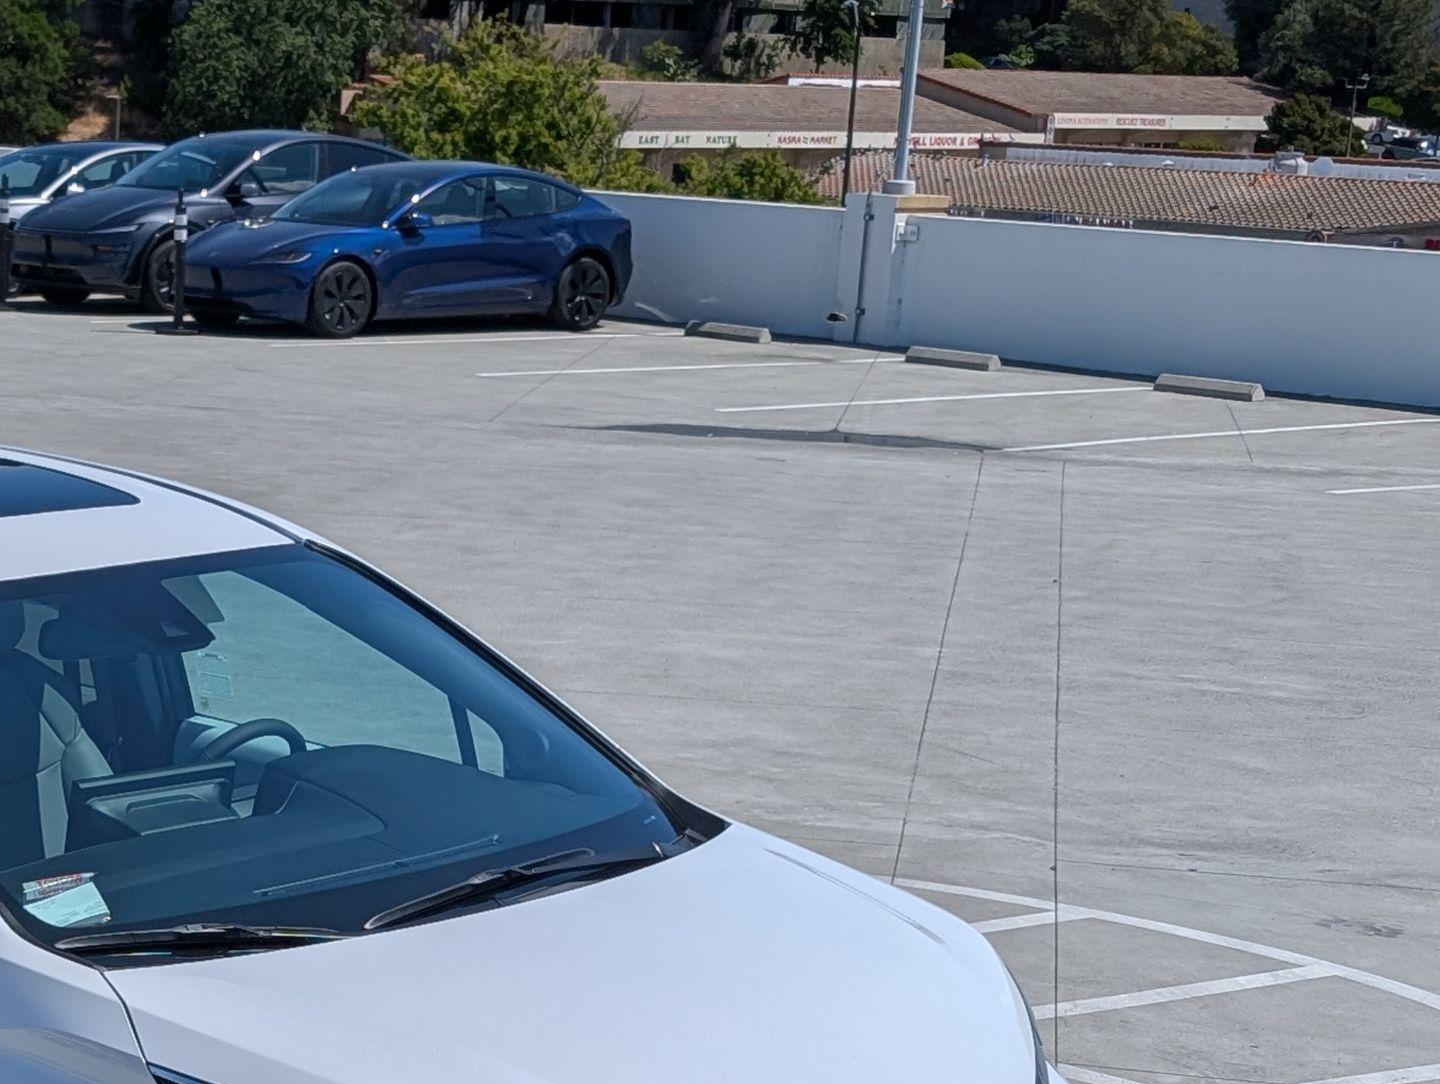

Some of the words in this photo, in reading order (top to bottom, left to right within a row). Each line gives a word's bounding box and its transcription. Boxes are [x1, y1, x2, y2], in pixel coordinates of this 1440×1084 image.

[638, 136, 660, 145] EAST
[674, 136, 690, 144] BAY
[810, 136, 837, 145] MARKET
[929, 136, 957, 146] LIQUOR
